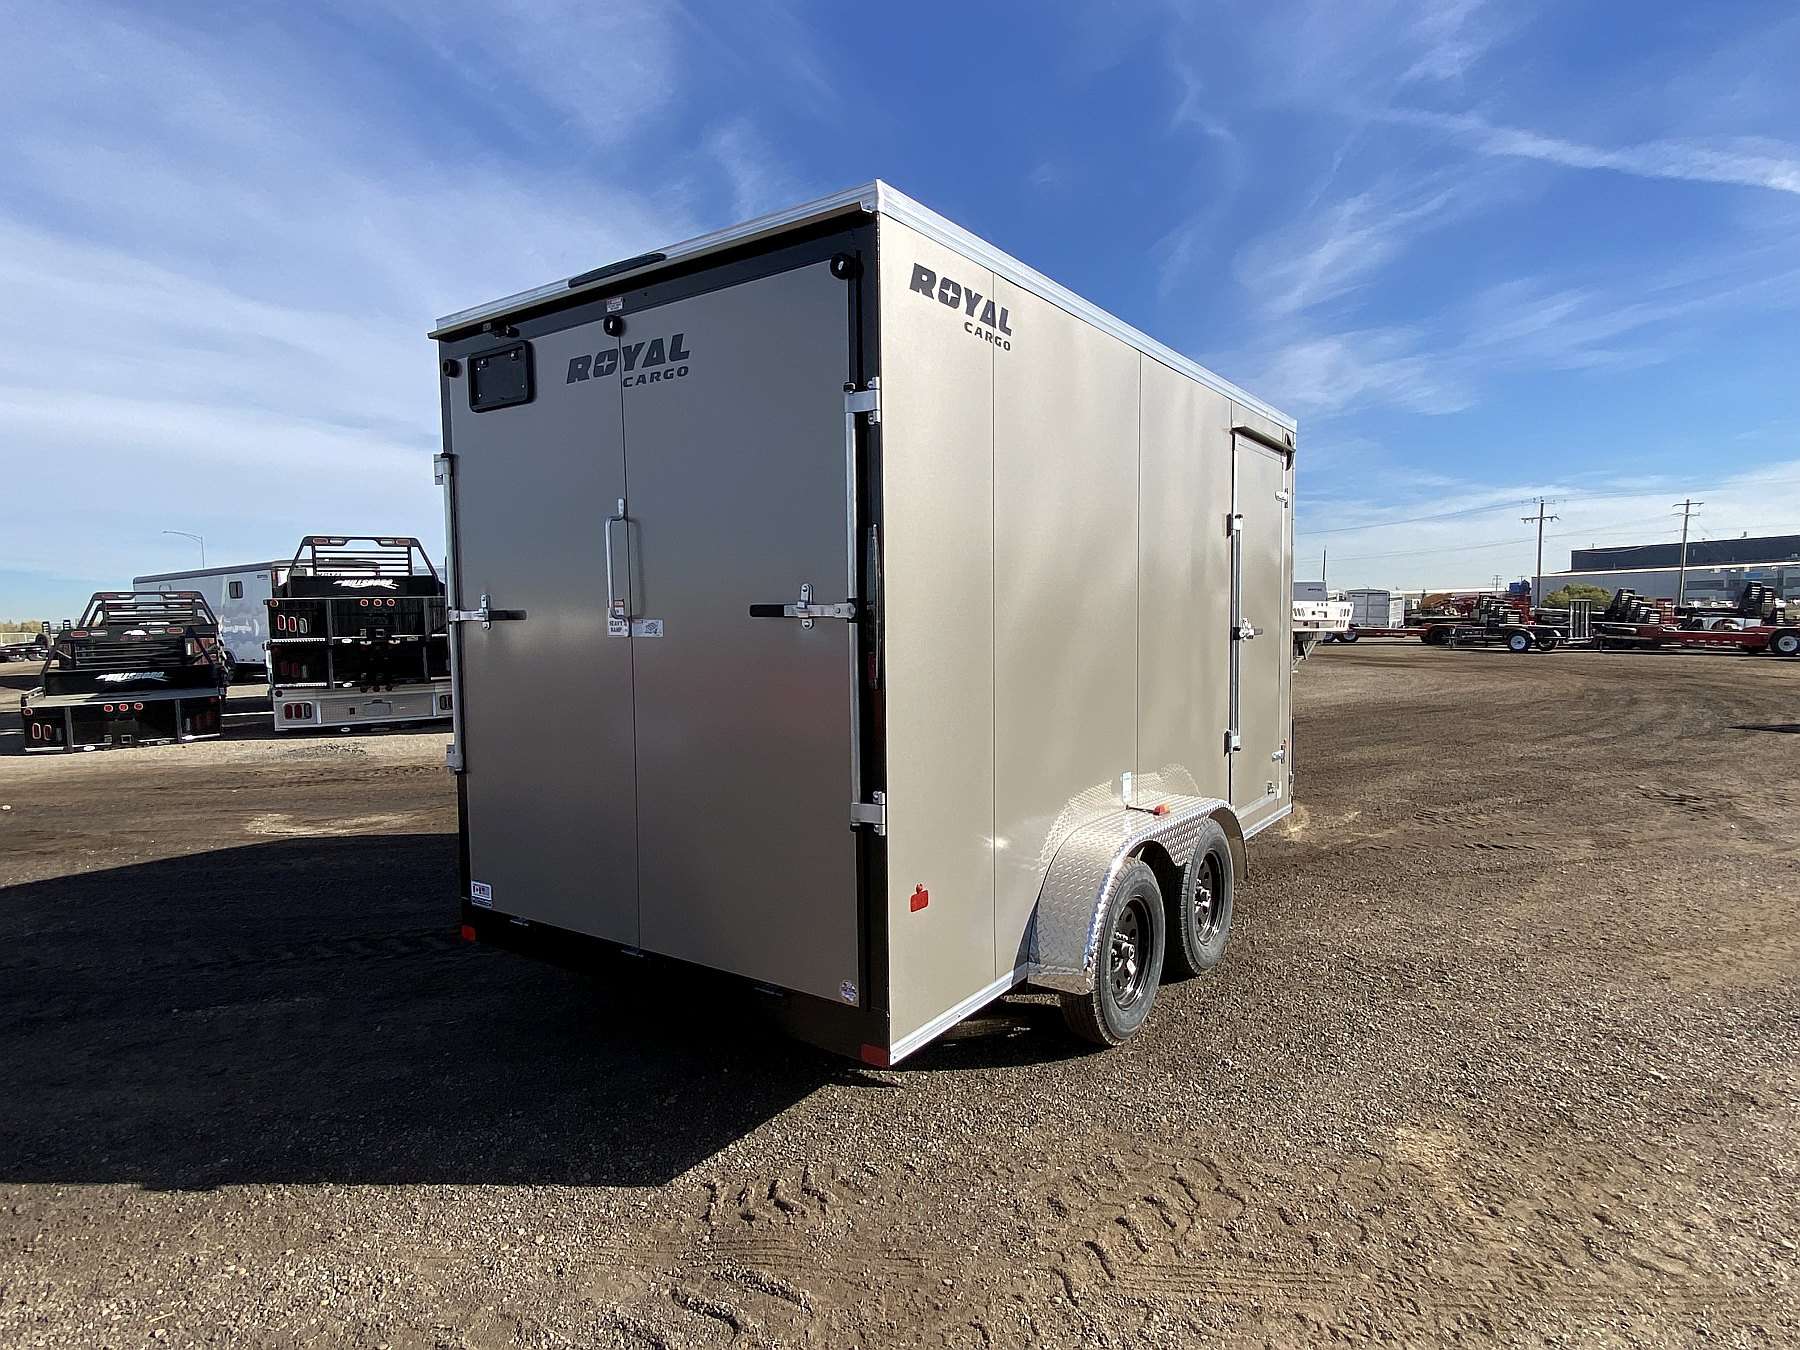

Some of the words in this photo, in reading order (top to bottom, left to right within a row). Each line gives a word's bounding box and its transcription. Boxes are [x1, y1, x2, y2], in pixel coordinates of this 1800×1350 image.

[909, 262, 1012, 337] ROYAL
[963, 321, 1011, 352] CARGO
[566, 333, 691, 385] ROYAL
[623, 366, 690, 388] CARGO
